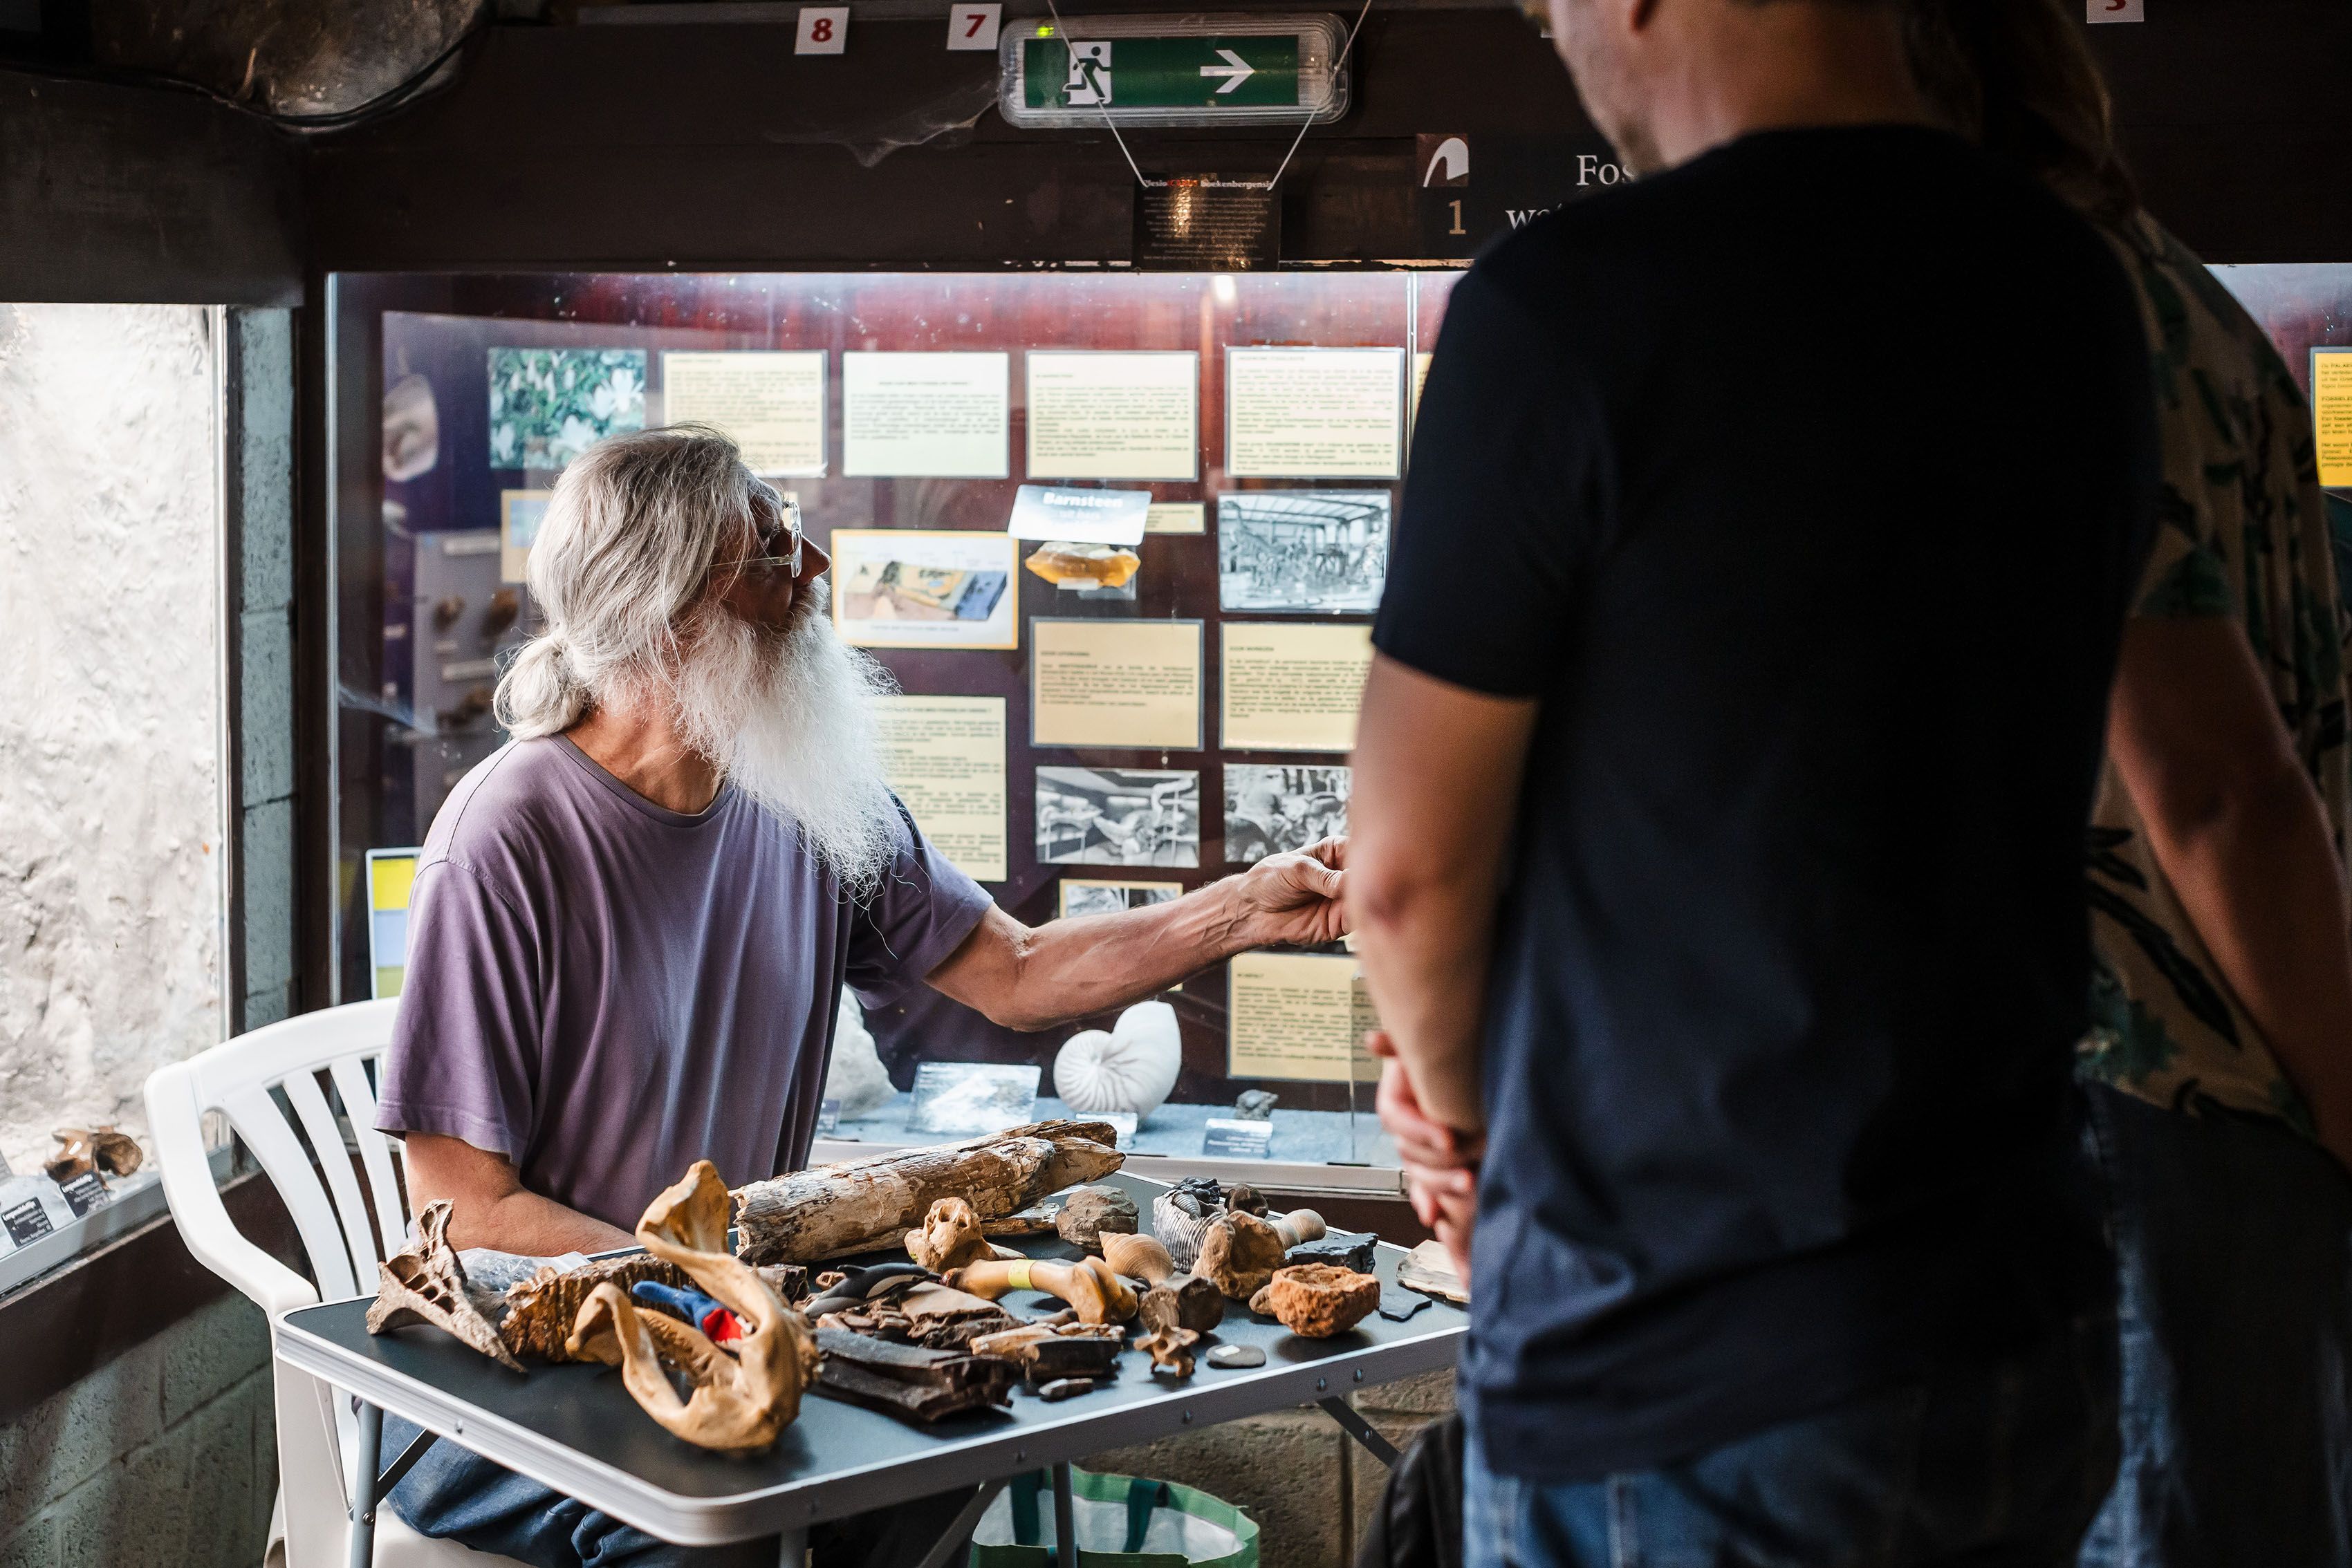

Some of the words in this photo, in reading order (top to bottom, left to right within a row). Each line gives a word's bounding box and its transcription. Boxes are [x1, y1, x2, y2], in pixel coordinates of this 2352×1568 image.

[811, 18, 833, 43] 8
[965, 14, 987, 38] 7
[1448, 200, 1467, 235] 1
[1043, 492, 1123, 509] Barnsteen
